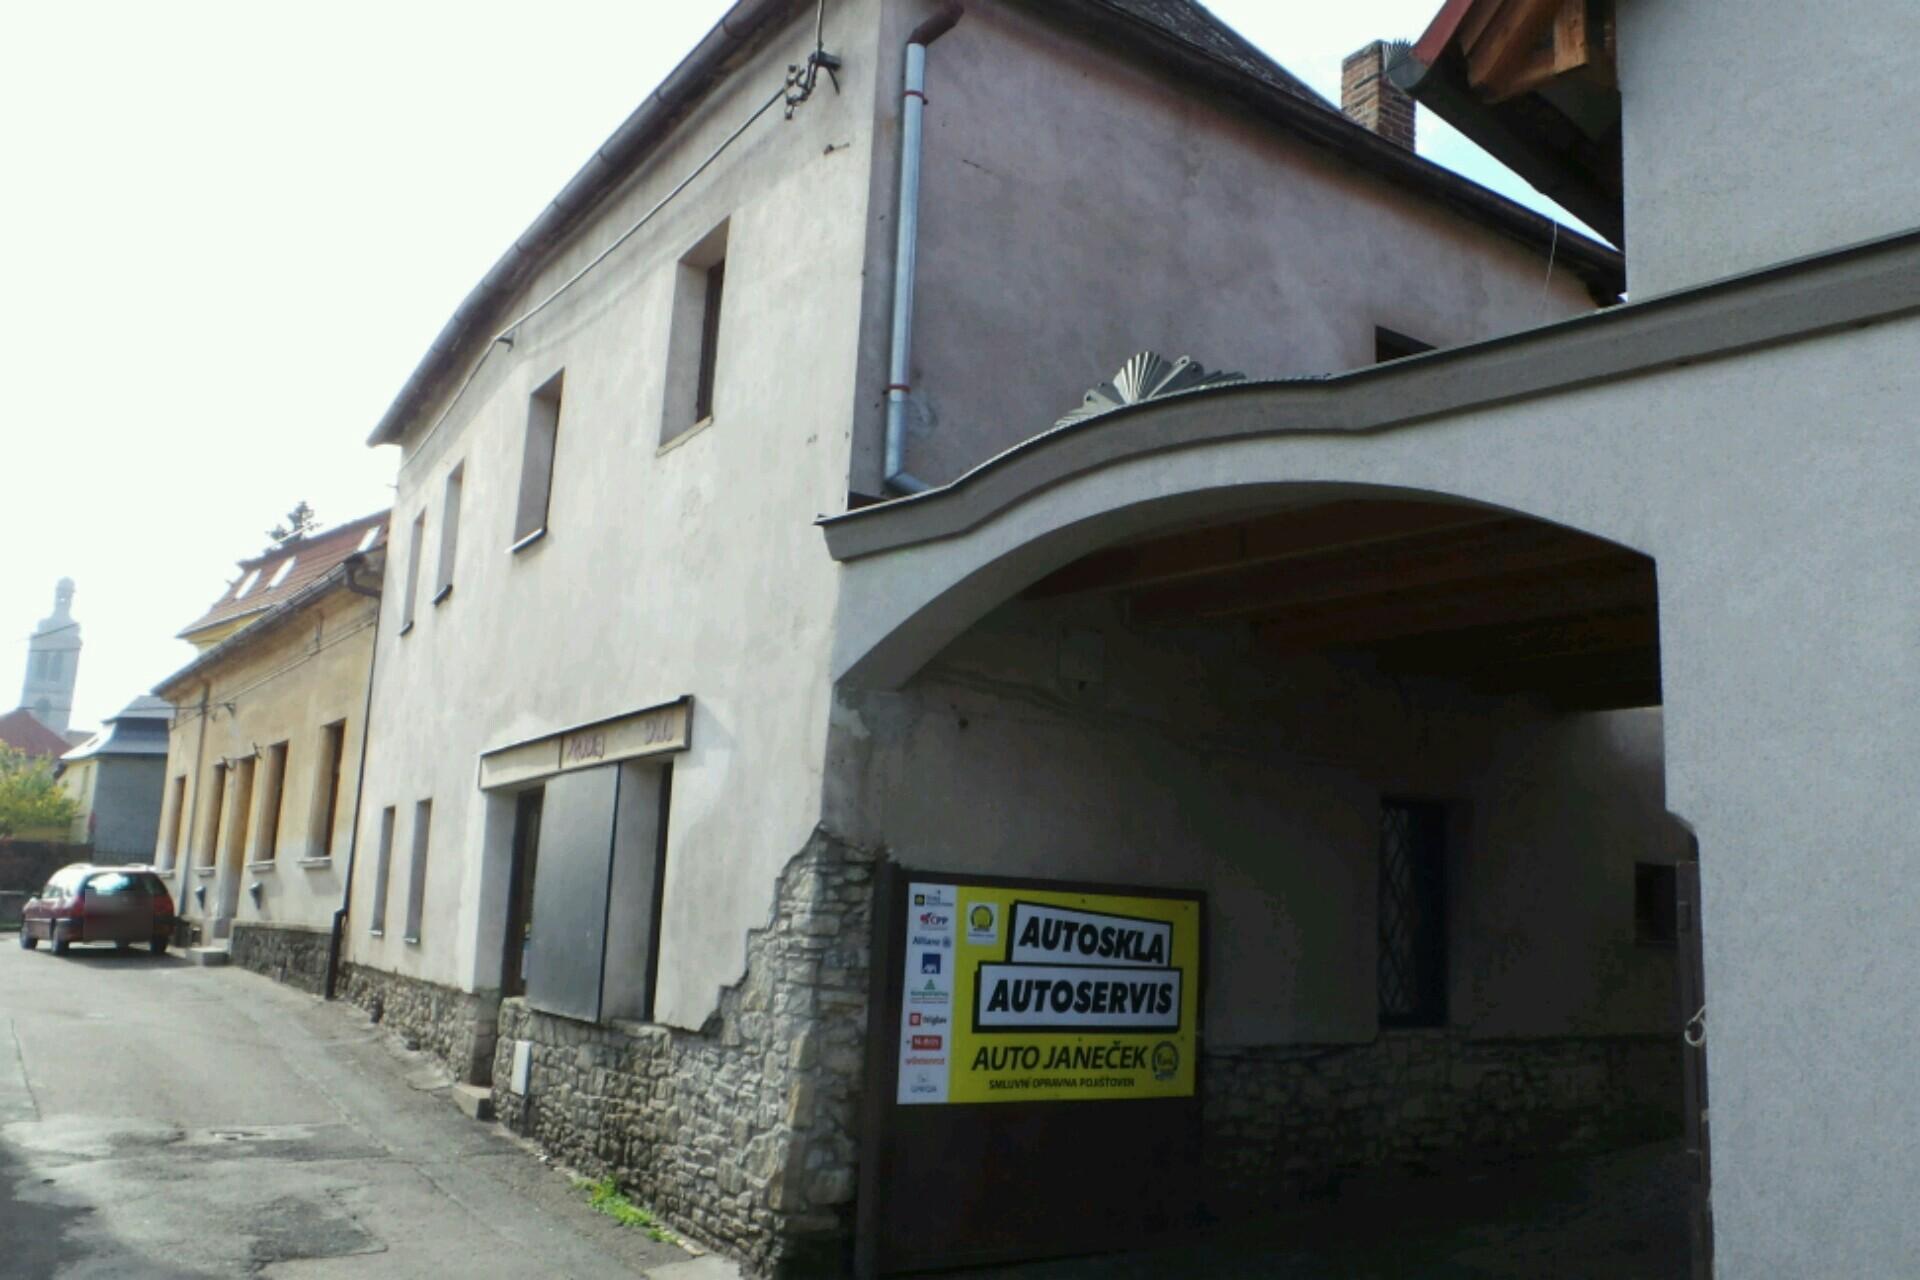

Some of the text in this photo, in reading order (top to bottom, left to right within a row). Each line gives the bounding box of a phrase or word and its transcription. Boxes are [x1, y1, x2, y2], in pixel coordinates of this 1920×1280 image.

[1018, 916, 1164, 963] AUTOSKLA
[986, 979, 1173, 1014] AUTOSERVIS
[971, 1045, 1040, 1071] AUTO
[1042, 1040, 1148, 1070] JANEČEK
